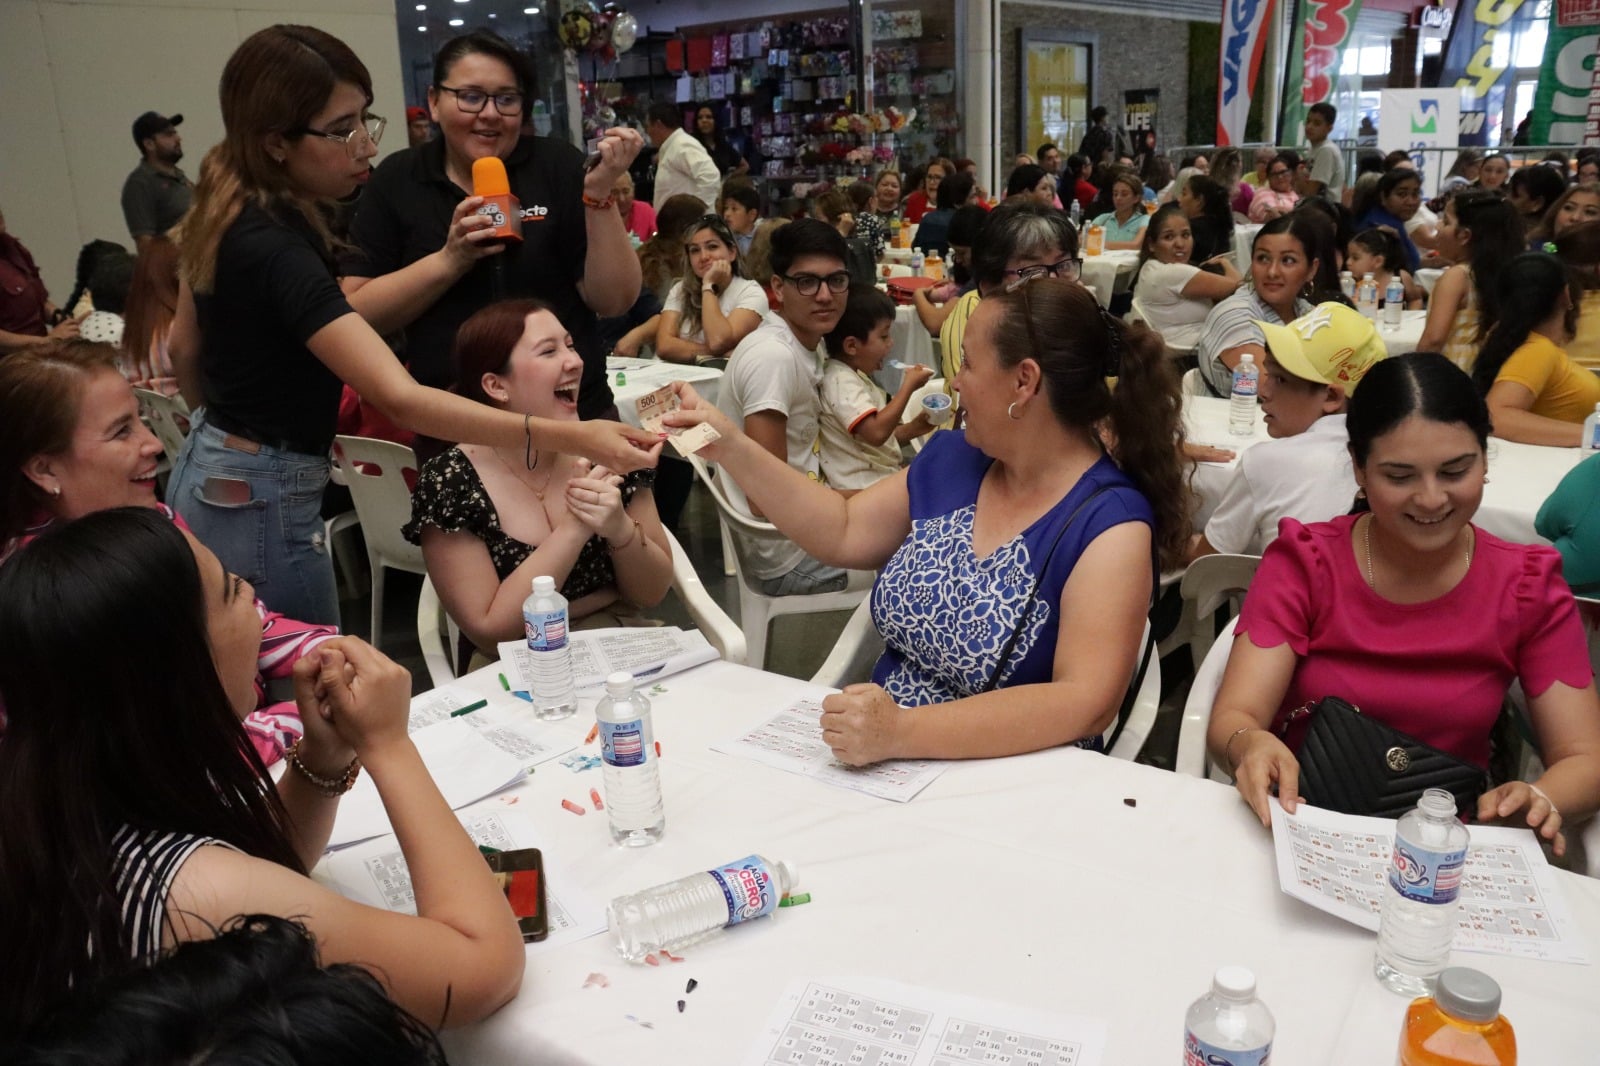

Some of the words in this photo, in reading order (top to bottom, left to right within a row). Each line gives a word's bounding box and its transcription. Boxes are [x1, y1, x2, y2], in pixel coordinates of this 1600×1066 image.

[1124, 112, 1151, 130] LIFE
[640, 394, 656, 409] 500
[739, 870, 760, 908] CERO
[749, 867, 766, 892] AGUA
[807, 999, 814, 1007] 9
[831, 1005, 843, 1014] 24
[843, 1008, 856, 1017] 39
[882, 1019, 895, 1027] 66
[908, 1024, 921, 1033] 89
[824, 992, 834, 1000] 11
[849, 998, 861, 1006] 30
[875, 1005, 886, 1014] 54
[887, 1008, 899, 1017] 65
[813, 1013, 824, 1021] 15
[825, 1015, 838, 1024] 27
[852, 1022, 863, 1031] 40
[864, 1026, 877, 1034] 57
[891, 1032, 903, 1040] 71
[803, 1031, 815, 1039] 12
[815, 1034, 828, 1042] 25
[855, 1044, 867, 1053] 55
[883, 1050, 895, 1059] 74
[895, 1054, 908, 1062] 81
[809, 1045, 822, 1053] 29
[823, 1048, 836, 1056] 32
[850, 1054, 863, 1063] 59
[958, 1047, 969, 1055] 17
[985, 1052, 997, 1060] 37
[999, 1055, 1011, 1063] 47
[974, 1040, 986, 1048] 28
[988, 1042, 1000, 1050] 36
[1016, 1048, 1028, 1056] 53
[1030, 1050, 1043, 1058] 68
[1059, 1055, 1071, 1064] 90
[1006, 1035, 1018, 1043] 43
[1048, 1043, 1060, 1051] 79
[1062, 1045, 1074, 1053] 83
[1185, 1038, 1205, 1061] GUA
[791, 1052, 803, 1060] 14
[818, 1058, 830, 1066] 38
